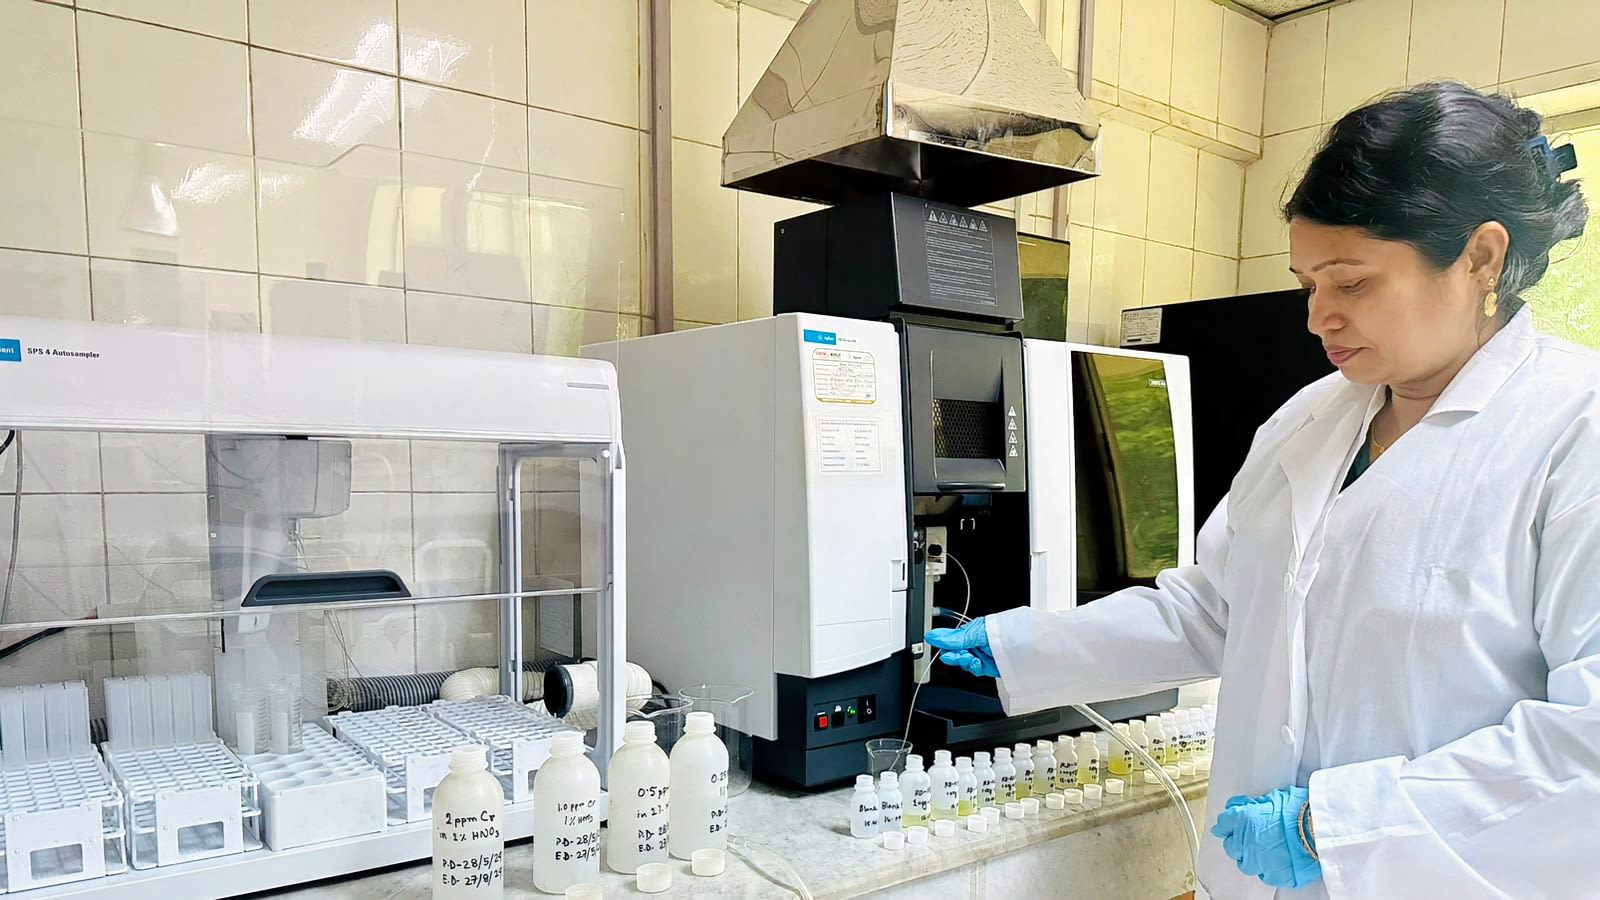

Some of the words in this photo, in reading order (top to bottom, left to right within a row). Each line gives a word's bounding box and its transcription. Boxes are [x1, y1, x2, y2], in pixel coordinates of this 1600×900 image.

[27, 347, 44, 355] SPS
[52, 348, 100, 359] Autosampler
[445, 812, 452, 825] 2
[454, 816, 478, 828] ppm
[480, 810, 496, 822] Cr
[636, 809, 647, 818] in
[472, 826, 500, 840] HNO3
